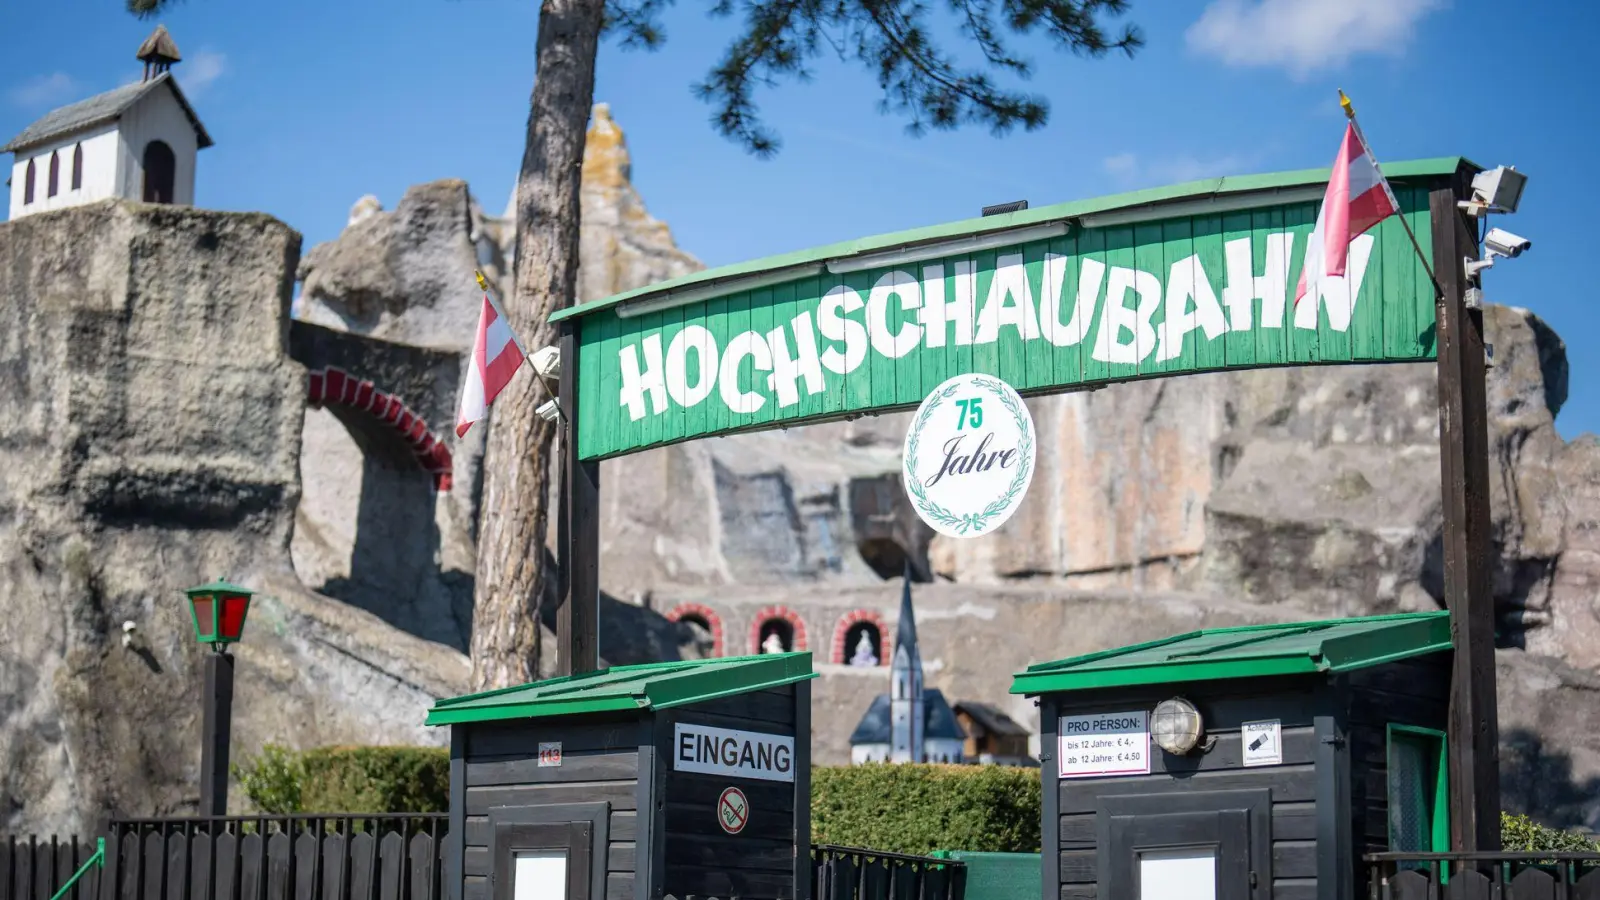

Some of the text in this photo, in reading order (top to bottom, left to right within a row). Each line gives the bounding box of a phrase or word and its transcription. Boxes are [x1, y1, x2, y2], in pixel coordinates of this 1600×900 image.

[618, 231, 1375, 422] HOCHSCHAUBAHN
[955, 397, 983, 431] 75
[924, 432, 1017, 488] Jahre
[1067, 718, 1140, 732] PRO PERSON:
[679, 732, 791, 773] EINGANG
[1067, 738, 1134, 749] bis 12 Jahre: € 4,-
[540, 749, 560, 763] 113
[1067, 752, 1140, 764] ab 12 Jahre: € 4,50
